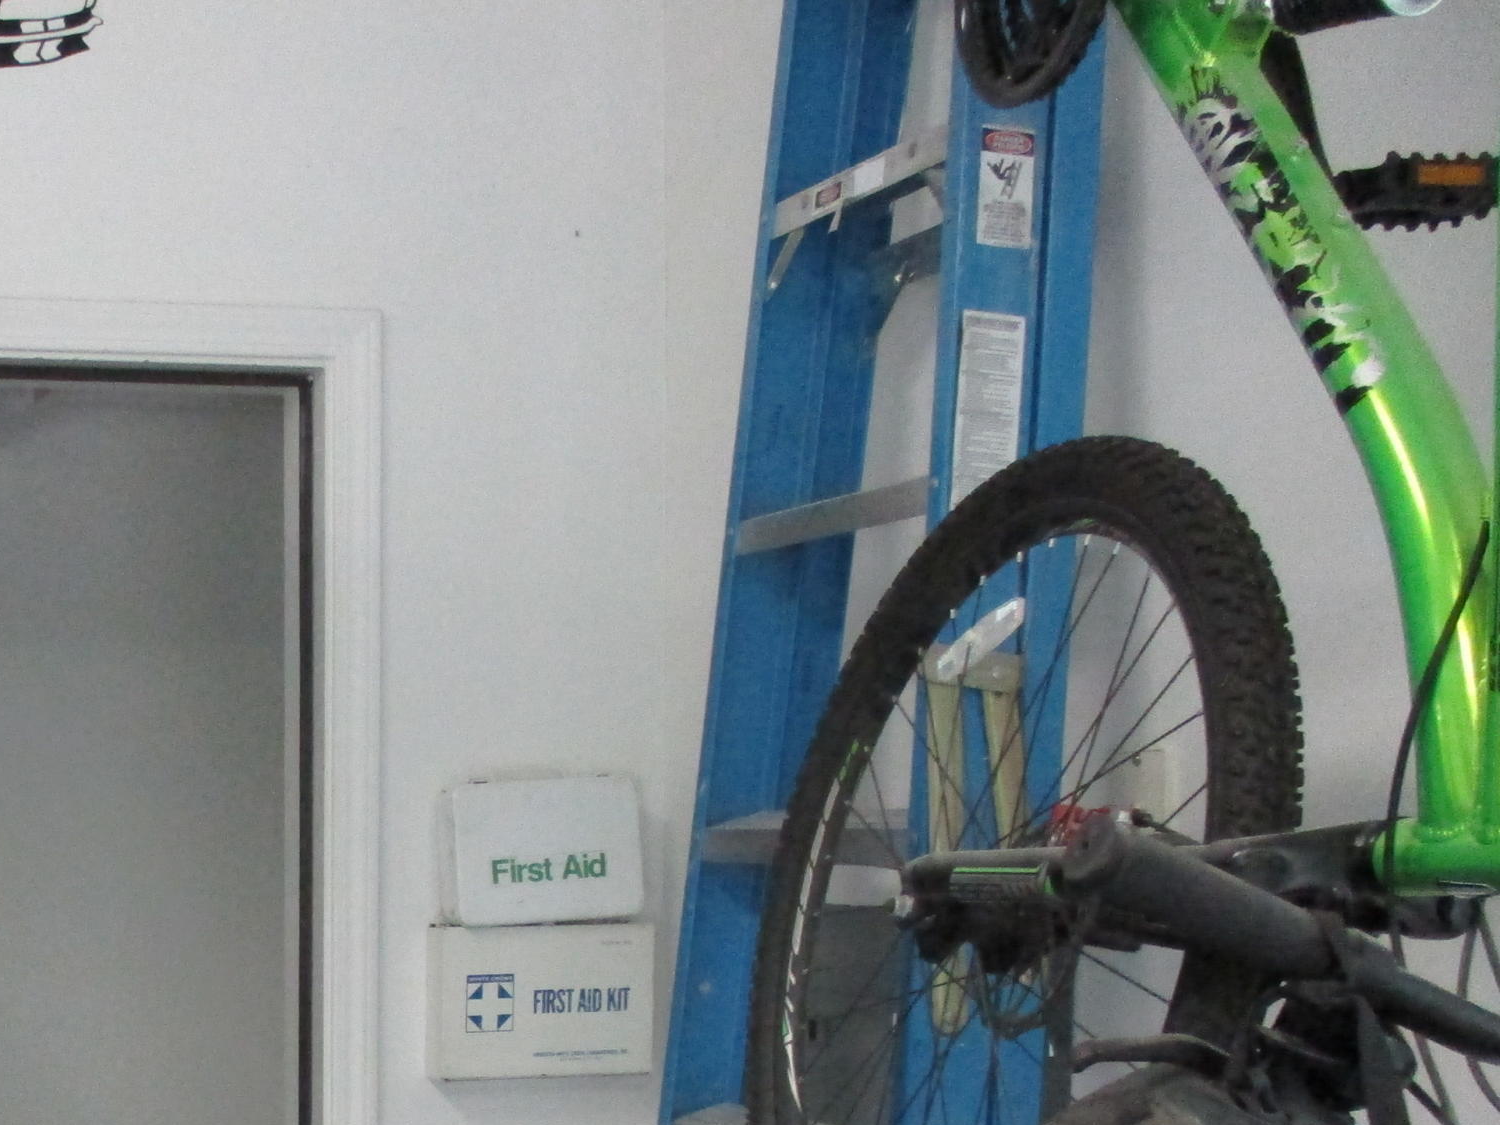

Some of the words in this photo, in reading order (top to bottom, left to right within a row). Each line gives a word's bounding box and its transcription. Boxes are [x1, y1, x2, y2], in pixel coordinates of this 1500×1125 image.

[491, 858, 553, 884] First
[563, 852, 606, 879] Aid
[533, 988, 575, 1014] FIRST
[577, 988, 602, 1013] AID
[606, 987, 631, 1012] KIT
